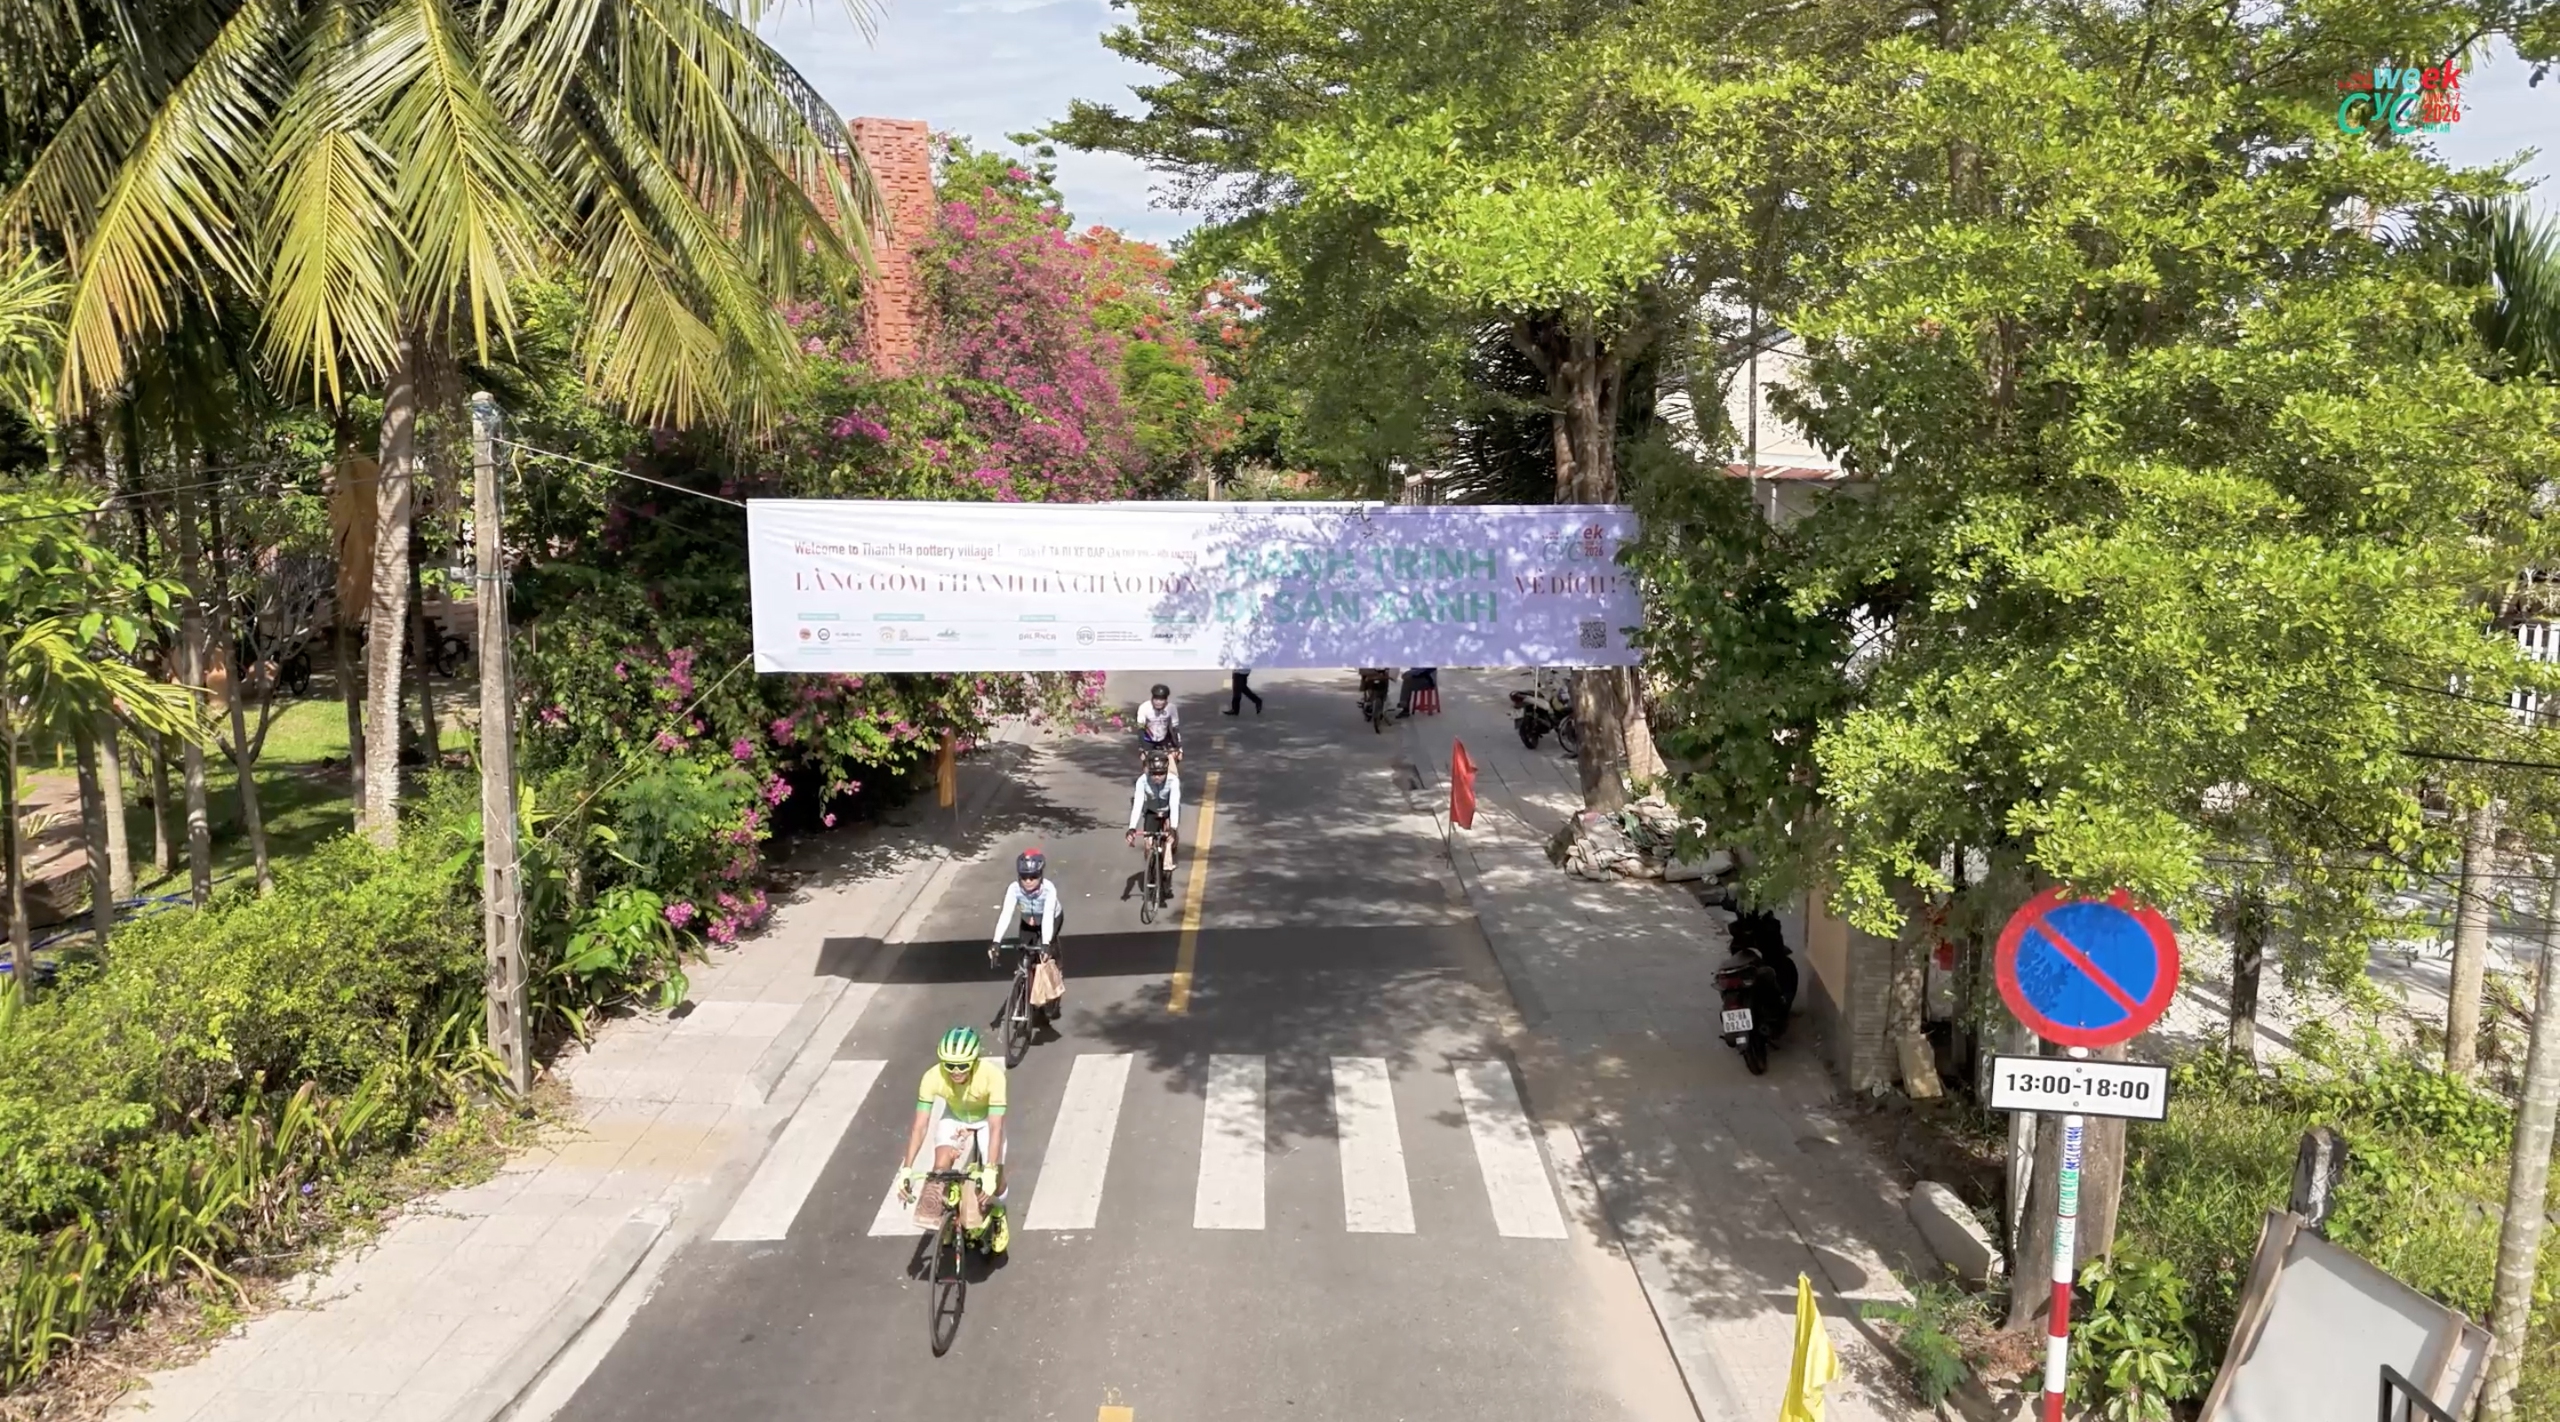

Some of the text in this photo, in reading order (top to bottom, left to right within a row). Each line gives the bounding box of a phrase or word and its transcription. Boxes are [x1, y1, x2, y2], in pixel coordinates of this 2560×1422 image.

[794, 542, 845, 556] Welcome
[849, 543, 859, 556] to
[862, 542, 895, 556] Thanh
[898, 542, 913, 557] Ha
[916, 543, 954, 560] pottery
[957, 543, 994, 561] village
[796, 567, 862, 591] LÀNG
[937, 573, 1023, 593] THANH
[1032, 569, 1066, 593] HÀ
[1073, 571, 1142, 593] CHÀO
[1374, 591, 1498, 623] XANH
[2005, 1072, 2150, 1101] 13:00-18:00
